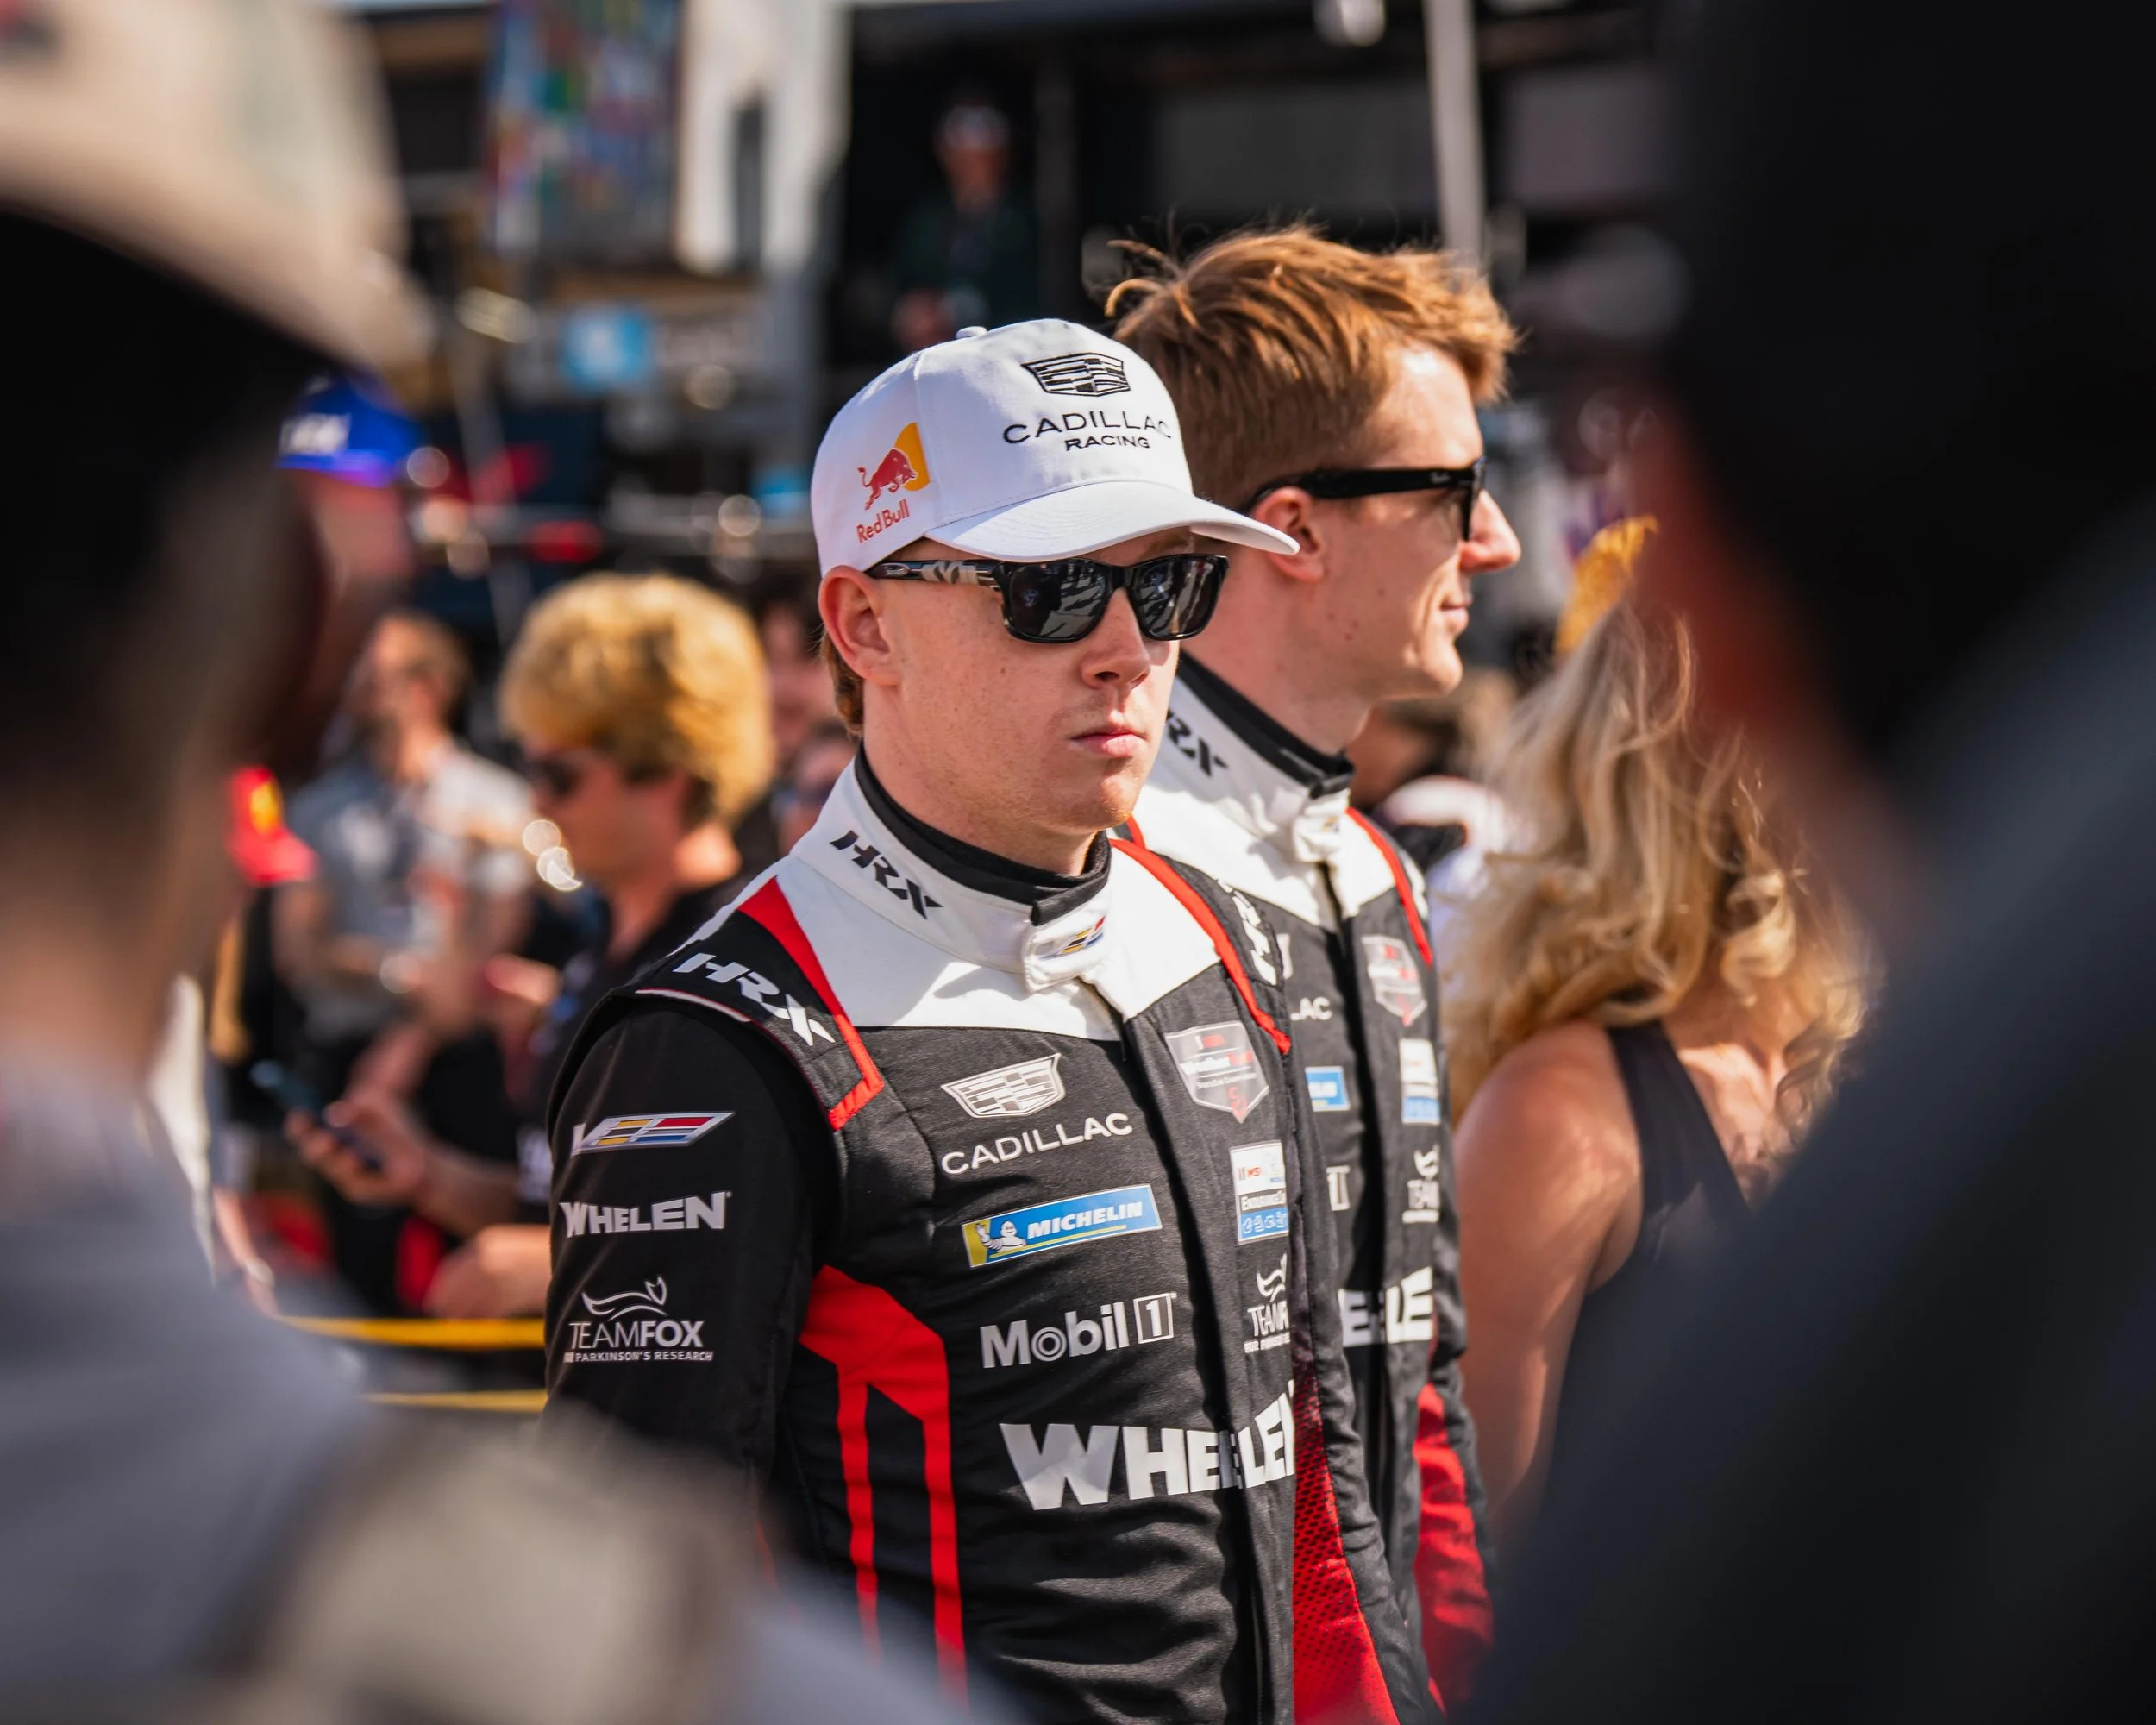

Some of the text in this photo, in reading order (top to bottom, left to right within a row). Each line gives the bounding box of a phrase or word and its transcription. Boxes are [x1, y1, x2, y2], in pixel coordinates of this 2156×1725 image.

[1003, 411, 1171, 444] CADILLAC
[1064, 435, 1150, 451] RACING
[856, 499, 910, 543] Red Bull
[1166, 708, 1229, 778] RX
[830, 830, 943, 919] HRX
[673, 952, 836, 1046] HRX
[941, 1113, 1133, 1174] CADILLAC
[559, 1191, 726, 1239] WHELEN
[1027, 1201, 1144, 1239] MICHELIN
[575, 1351, 651, 1363] PARKINSON'S
[654, 1352, 714, 1362] RESEARCH
[980, 1301, 1130, 1370] Mobil
